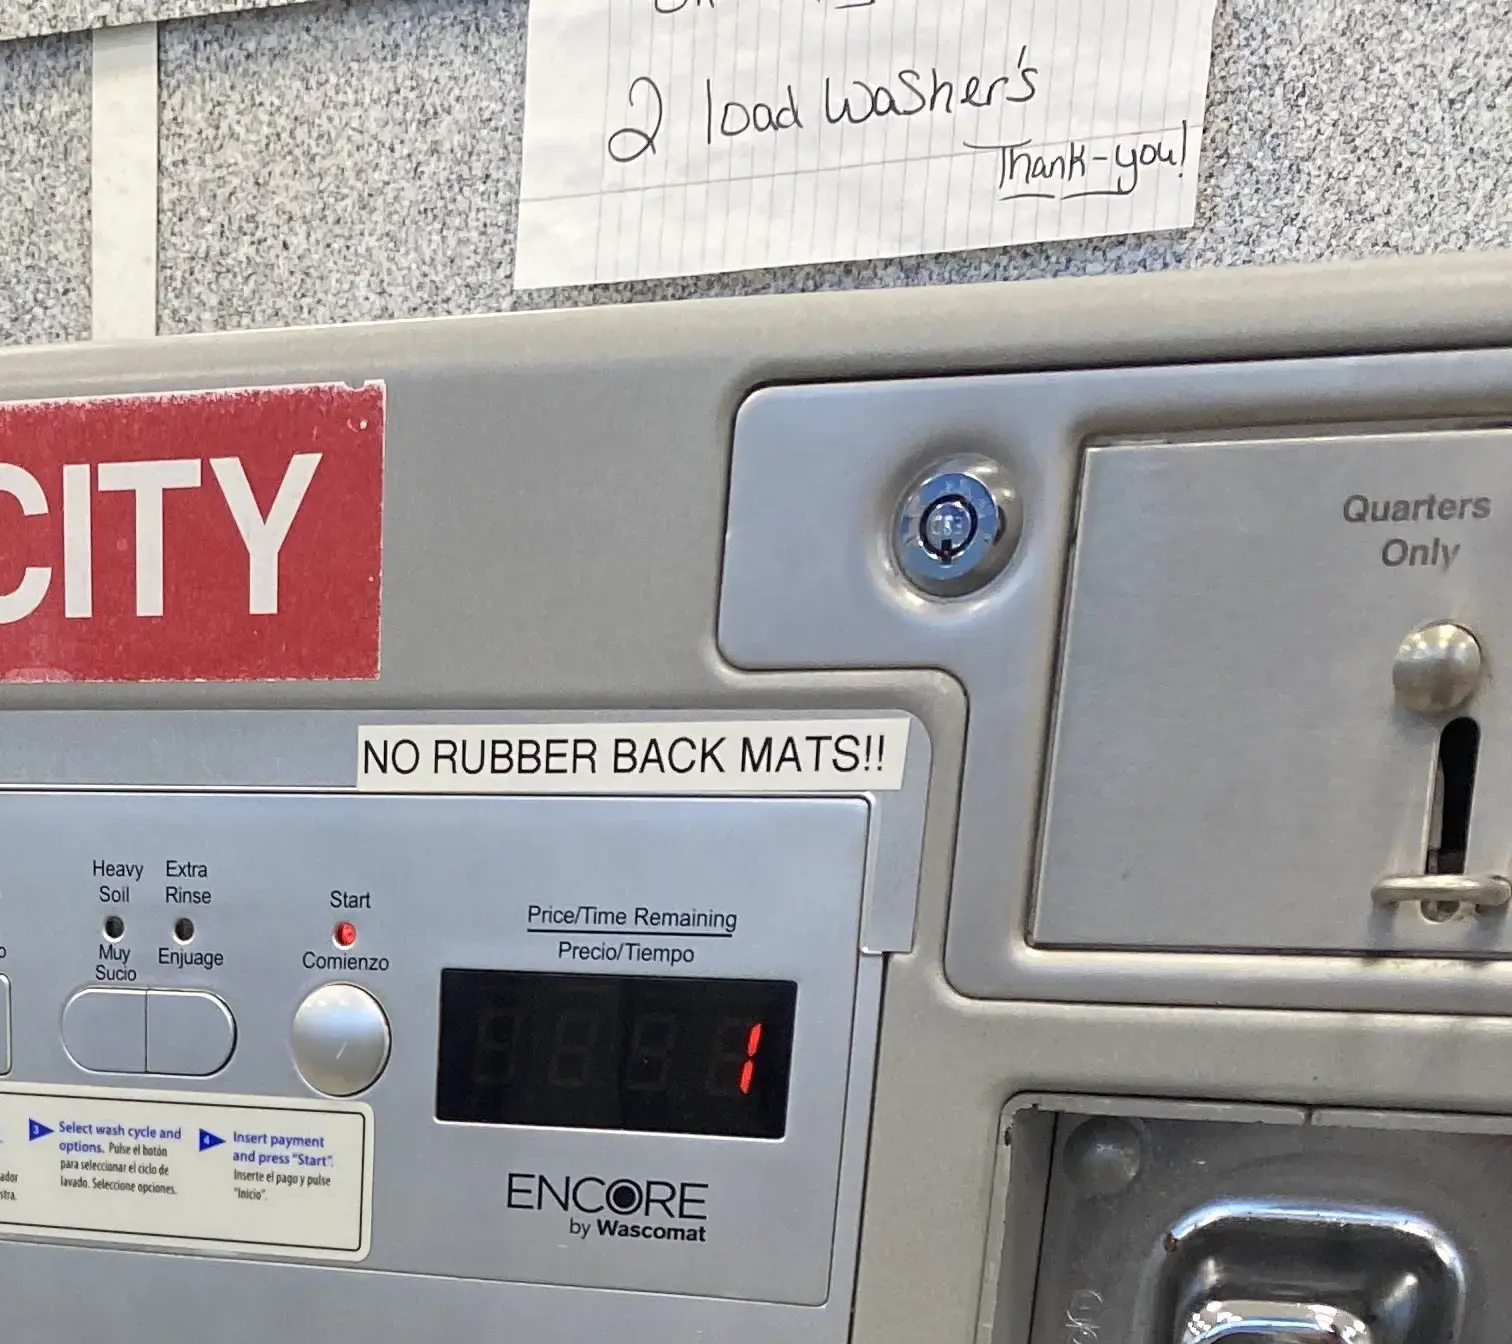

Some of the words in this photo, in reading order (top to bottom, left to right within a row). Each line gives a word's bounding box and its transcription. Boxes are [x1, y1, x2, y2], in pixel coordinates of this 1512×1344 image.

[608, 76, 664, 162] 2
[706, 80, 803, 144] load
[1342, 493, 1492, 524] Quarters
[1381, 538, 1460, 571] Only
[363, 739, 420, 775] NO
[433, 738, 598, 776] RUBBER
[612, 737, 728, 775] BACK
[739, 735, 885, 774] MATS!!
[92, 860, 144, 881] Heavy
[166, 860, 208, 878] Extra
[99, 885, 130, 903] Soil
[165, 886, 211, 905] Rinse
[330, 890, 371, 909] Start
[528, 905, 627, 926] Price/Time
[634, 907, 738, 933] Remaining
[99, 944, 131, 964] Muy
[158, 948, 224, 970] Enjuage
[302, 951, 390, 972] Comienzo
[558, 942, 695, 965] Precio/Tiempo
[95, 964, 137, 982] Sucio
[739, 1023, 762, 1094] 1
[59, 1120, 93, 1135] Select
[96, 1123, 125, 1136] wash
[128, 1126, 157, 1140] cycle
[159, 1126, 182, 1140] and
[233, 1131, 268, 1144] Insert
[270, 1135, 324, 1149] payment
[59, 1141, 105, 1154] options.
[109, 1142, 131, 1155] Pulse
[133, 1144, 140, 1155] el
[233, 1150, 255, 1163] and
[258, 1154, 290, 1166] press
[60, 1159, 79, 1171] para
[81, 1160, 126, 1173] seleccionar
[128, 1162, 136, 1174] el
[138, 1162, 157, 1175] ciclo
[158, 1163, 169, 1176] de
[60, 1176, 90, 1189] lavado.
[92, 1177, 136, 1192] Seleccione
[137, 1182, 177, 1195] opciones.
[233, 1168, 265, 1182] Inserte
[266, 1170, 274, 1183] el
[276, 1173, 298, 1187] pago
[300, 1176, 305, 1187] y
[307, 1173, 331, 1188] pulse
[506, 1172, 710, 1222] ENCORE
[569, 1218, 590, 1239] by
[596, 1219, 707, 1243] Wascomat
